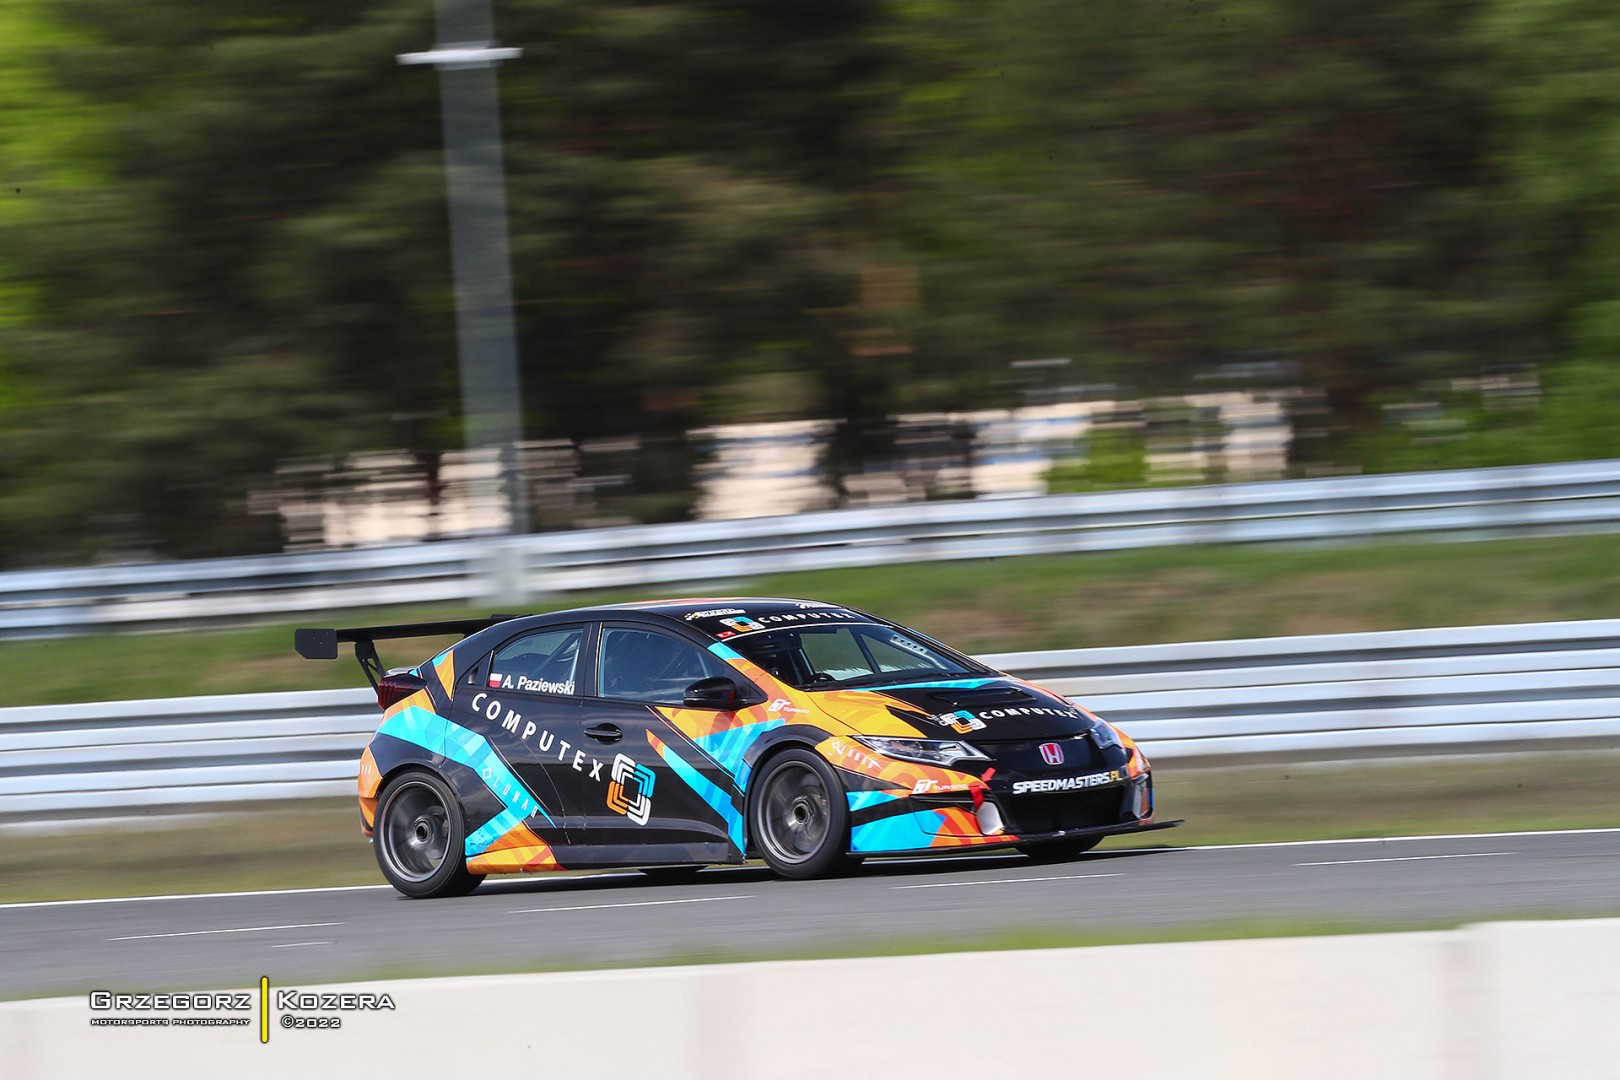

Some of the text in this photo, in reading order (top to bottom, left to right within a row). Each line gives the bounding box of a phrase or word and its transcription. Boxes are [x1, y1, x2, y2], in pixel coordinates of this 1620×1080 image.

[502, 675, 575, 695] A. Paziewski
[979, 707, 1079, 720] COMPUTEX
[471, 693, 604, 782] COMPUTEX
[493, 776, 539, 818] LUNAR
